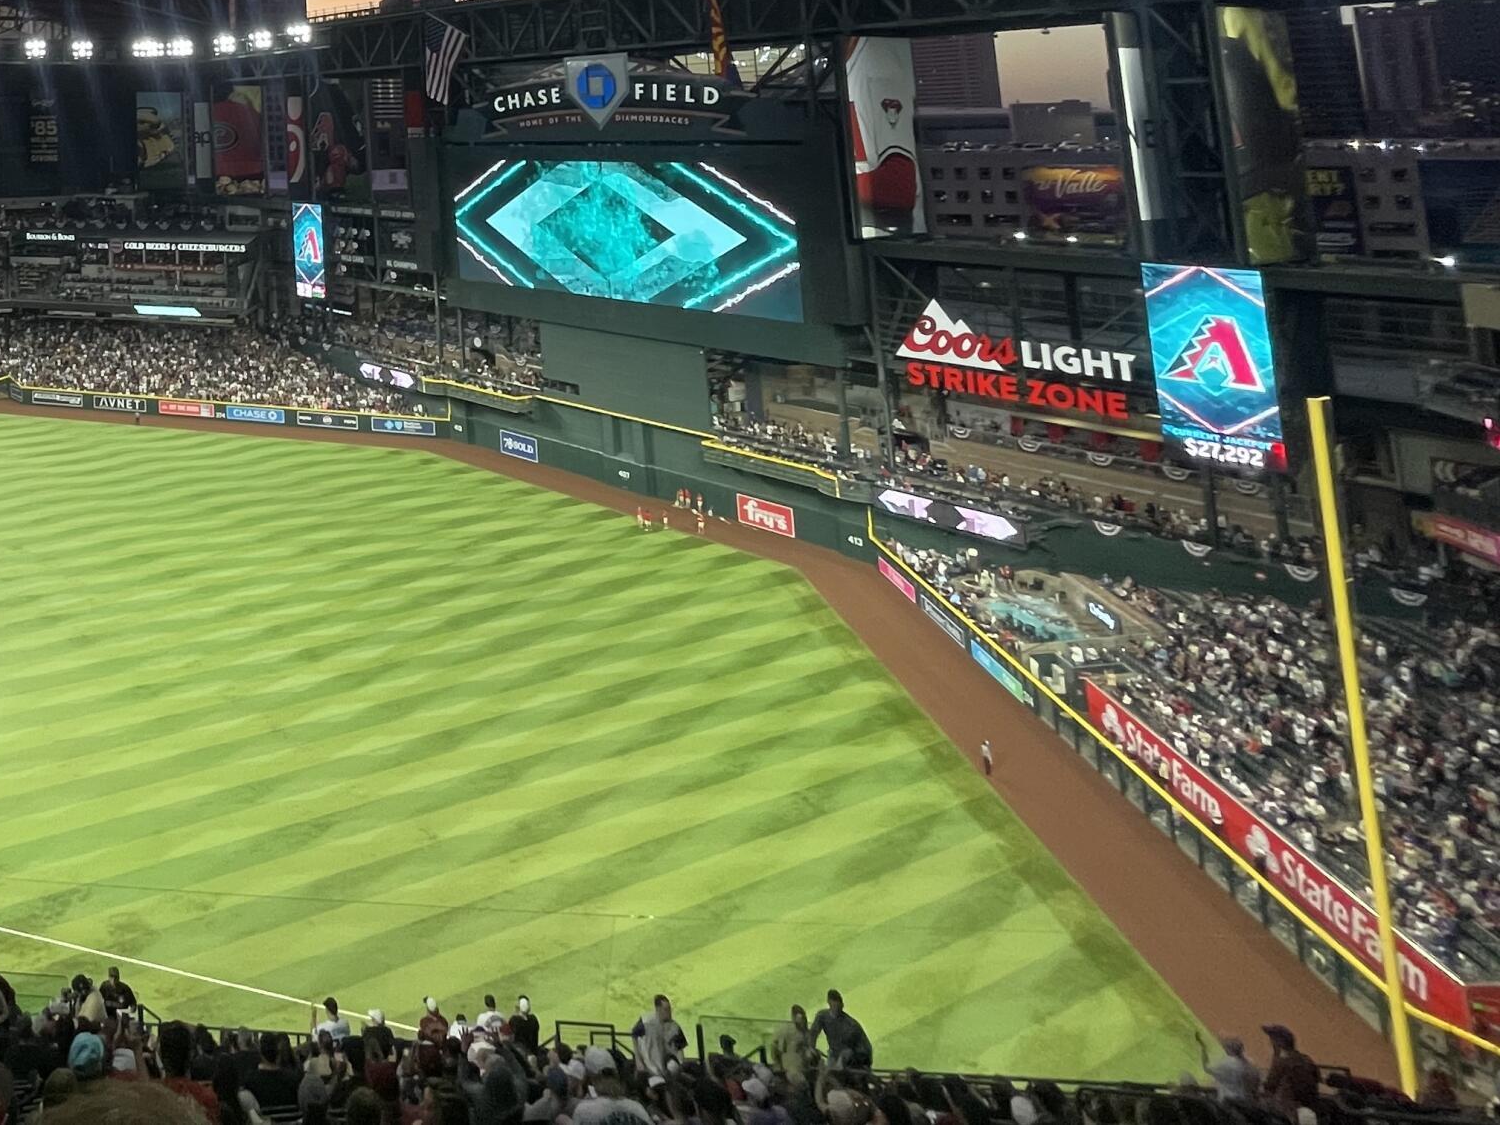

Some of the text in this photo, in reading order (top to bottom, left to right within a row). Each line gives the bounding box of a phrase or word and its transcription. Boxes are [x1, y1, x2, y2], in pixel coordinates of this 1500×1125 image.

[493, 82, 720, 113] CHASE FIELD
[518, 114, 690, 127] HOME OF THE DIAMONDBACKS
[178, 243, 246, 252] CHEESEBURGERS
[903, 315, 1137, 382] Coors LIGHT
[99, 397, 141, 410] AVNET
[906, 362, 1130, 420] STRIKE ZONE
[233, 409, 267, 420] CHASE
[1171, 428, 1273, 451] CURRENT JACKPOT
[1184, 437, 1265, 467] $27,292
[1281, 850, 1428, 1002] State Fam
